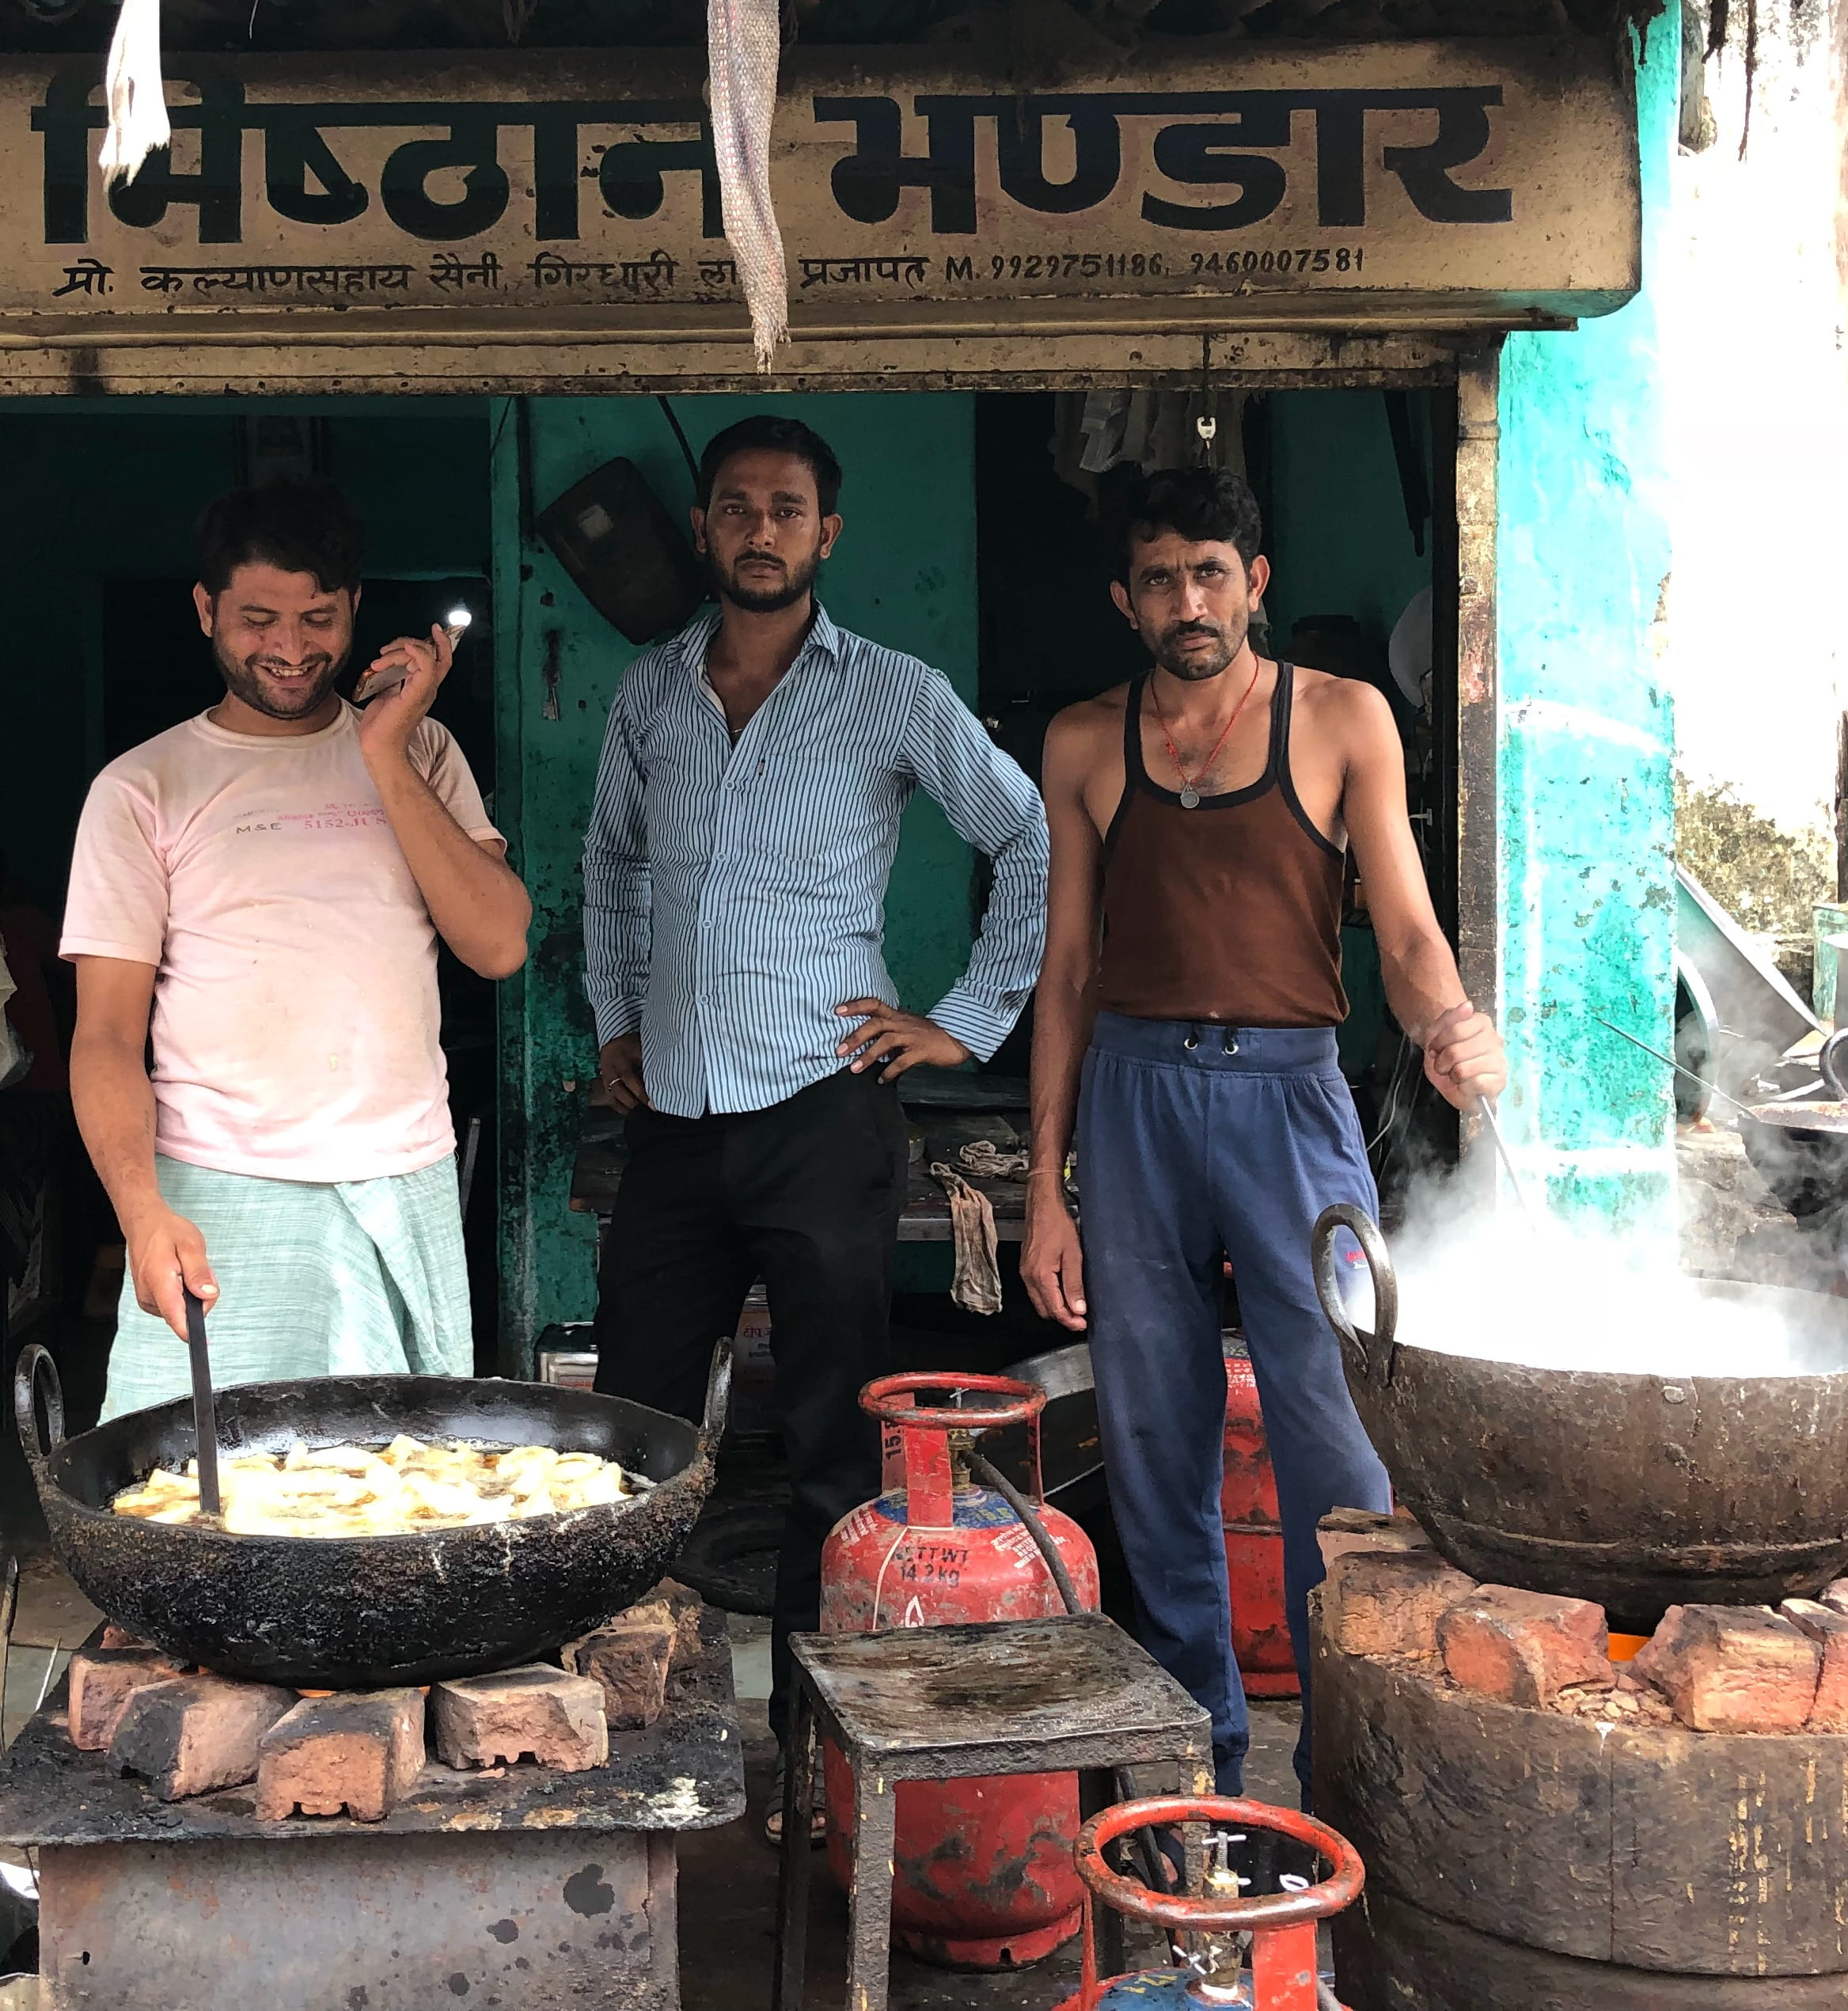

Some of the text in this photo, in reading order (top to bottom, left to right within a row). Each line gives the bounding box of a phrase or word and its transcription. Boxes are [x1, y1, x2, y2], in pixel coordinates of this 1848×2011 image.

[812, 85, 1512, 235] भण्डार
[139, 265, 413, 295] कल्याणसहाय
[696, 260, 738, 286] ला
[1190, 247, 1364, 275] 9460007581
